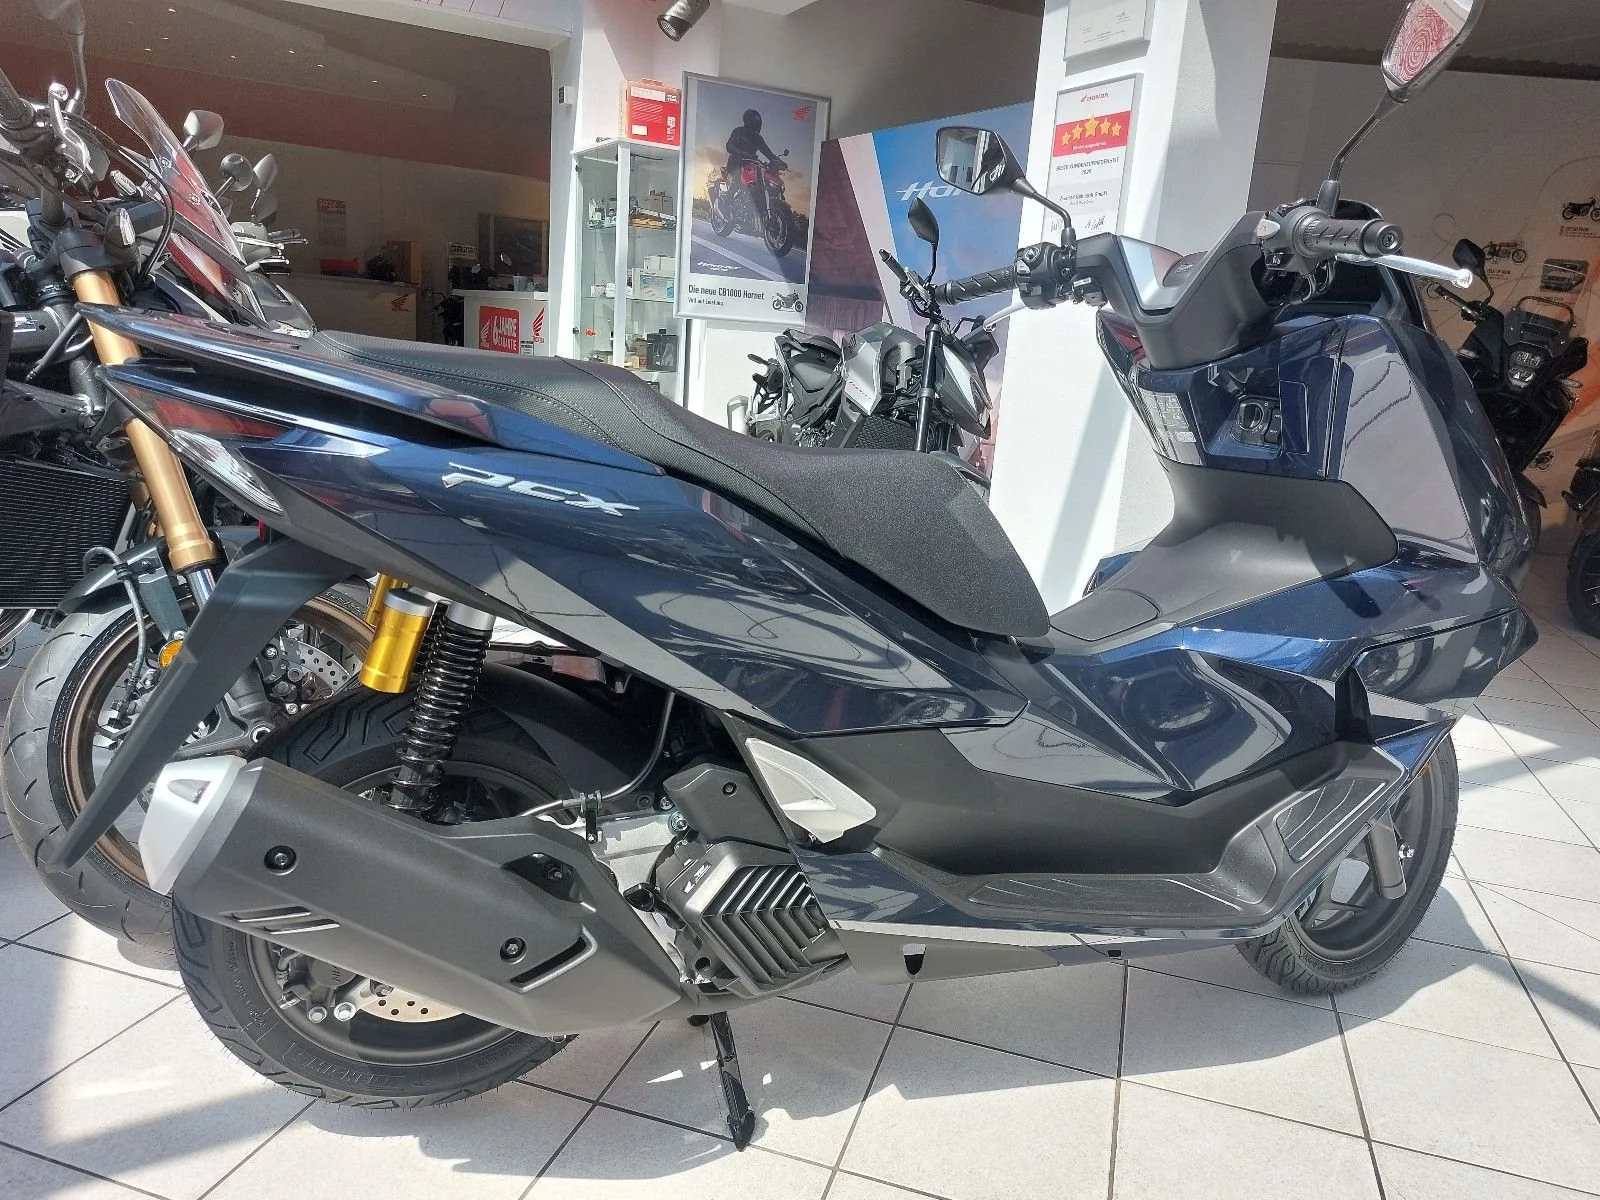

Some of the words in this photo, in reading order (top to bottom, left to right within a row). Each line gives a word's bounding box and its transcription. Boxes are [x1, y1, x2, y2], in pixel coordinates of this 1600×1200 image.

[688, 284, 700, 294] Die
[700, 287, 717, 296] neue
[718, 287, 742, 298] CB1000
[743, 289, 765, 300] Hornet
[441, 461, 641, 518] PCX
